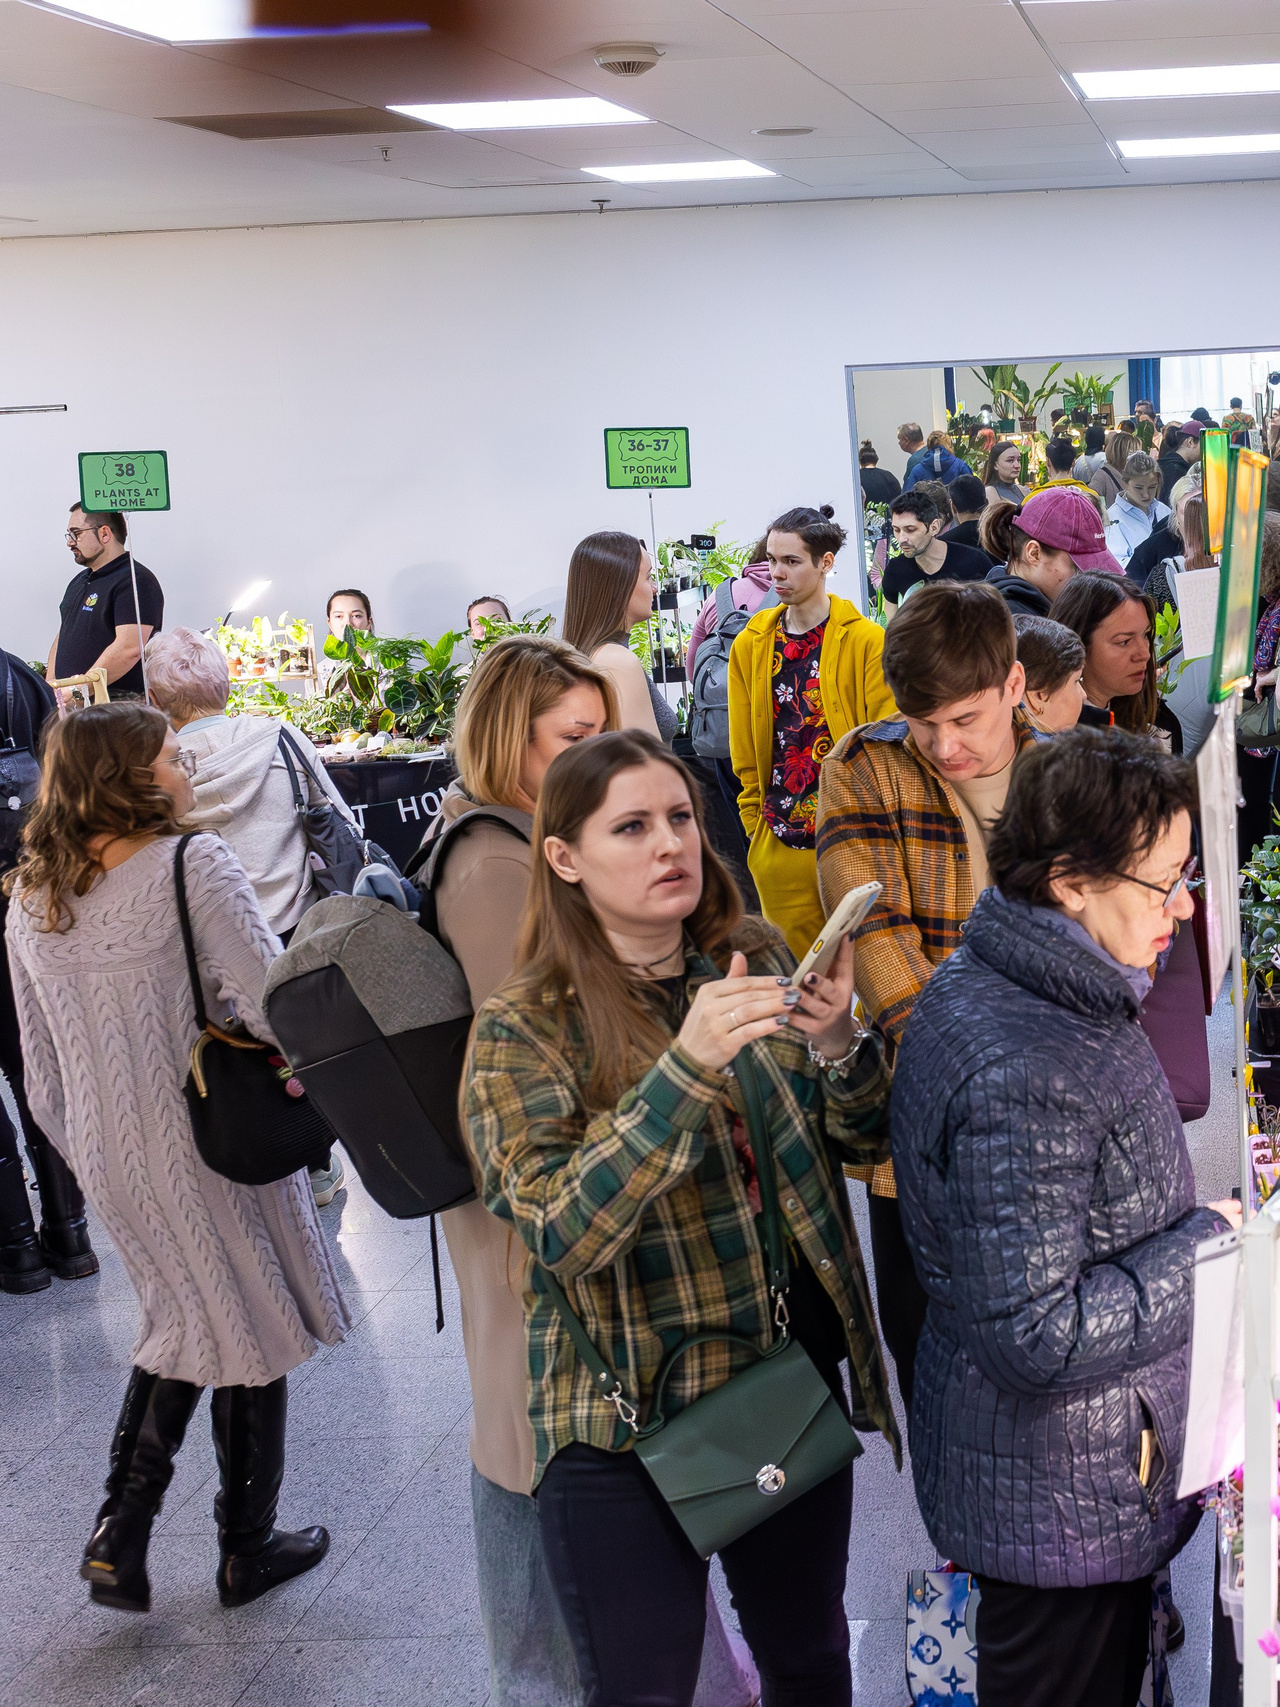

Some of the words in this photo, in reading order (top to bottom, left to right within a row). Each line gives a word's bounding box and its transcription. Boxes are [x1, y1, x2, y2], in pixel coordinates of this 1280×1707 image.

[627, 439, 670, 452] 36-37
[114, 462, 136, 477] 38
[622, 464, 677, 475] ТРОПИКИ
[632, 475, 669, 486] ДОМА
[94, 488, 141, 499] PLANTS
[145, 487, 160, 498] AT
[110, 498, 146, 508] HOME
